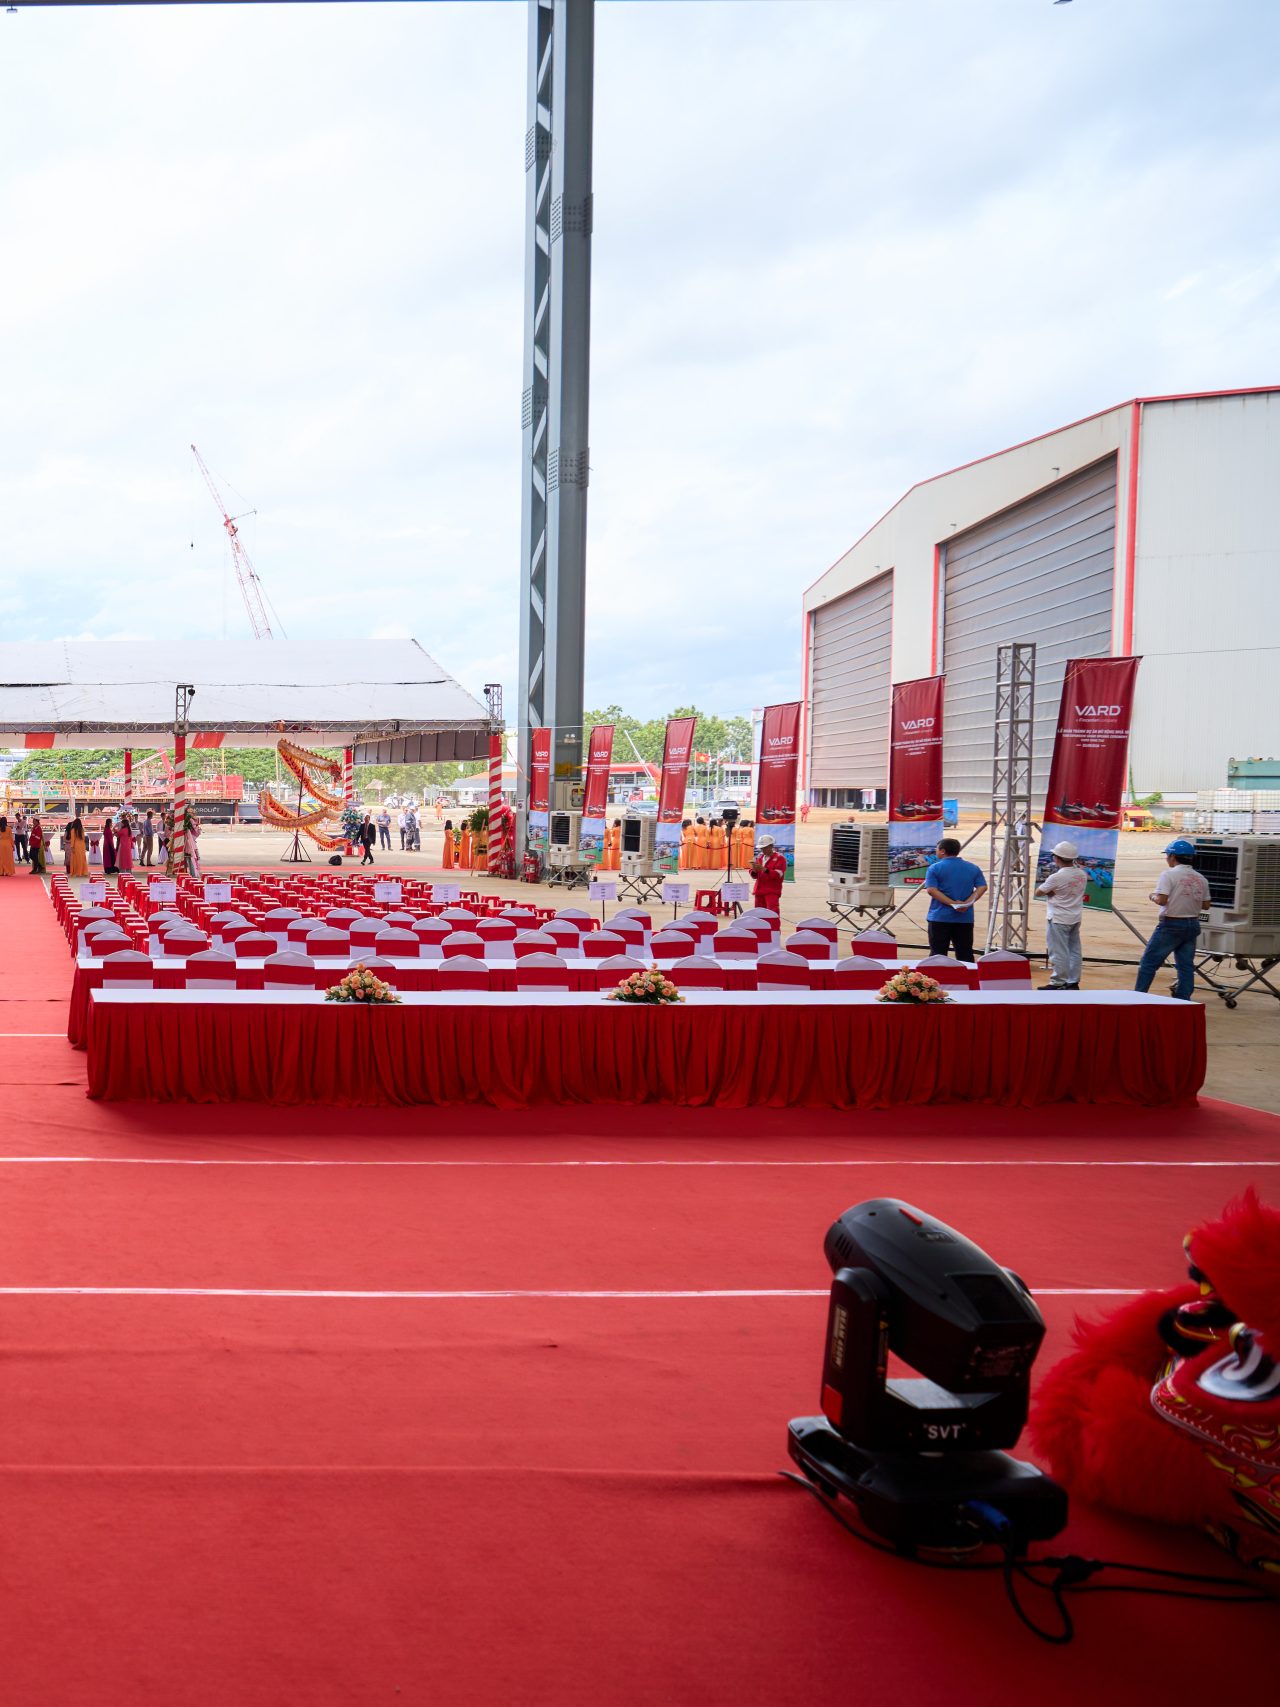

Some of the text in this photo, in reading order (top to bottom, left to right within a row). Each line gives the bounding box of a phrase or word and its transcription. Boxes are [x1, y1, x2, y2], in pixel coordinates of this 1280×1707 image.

[1074, 705, 1121, 716] VARD
[901, 717, 935, 730] VARD
[769, 736, 794, 746] VARD
[928, 1424, 961, 1439] SVT
